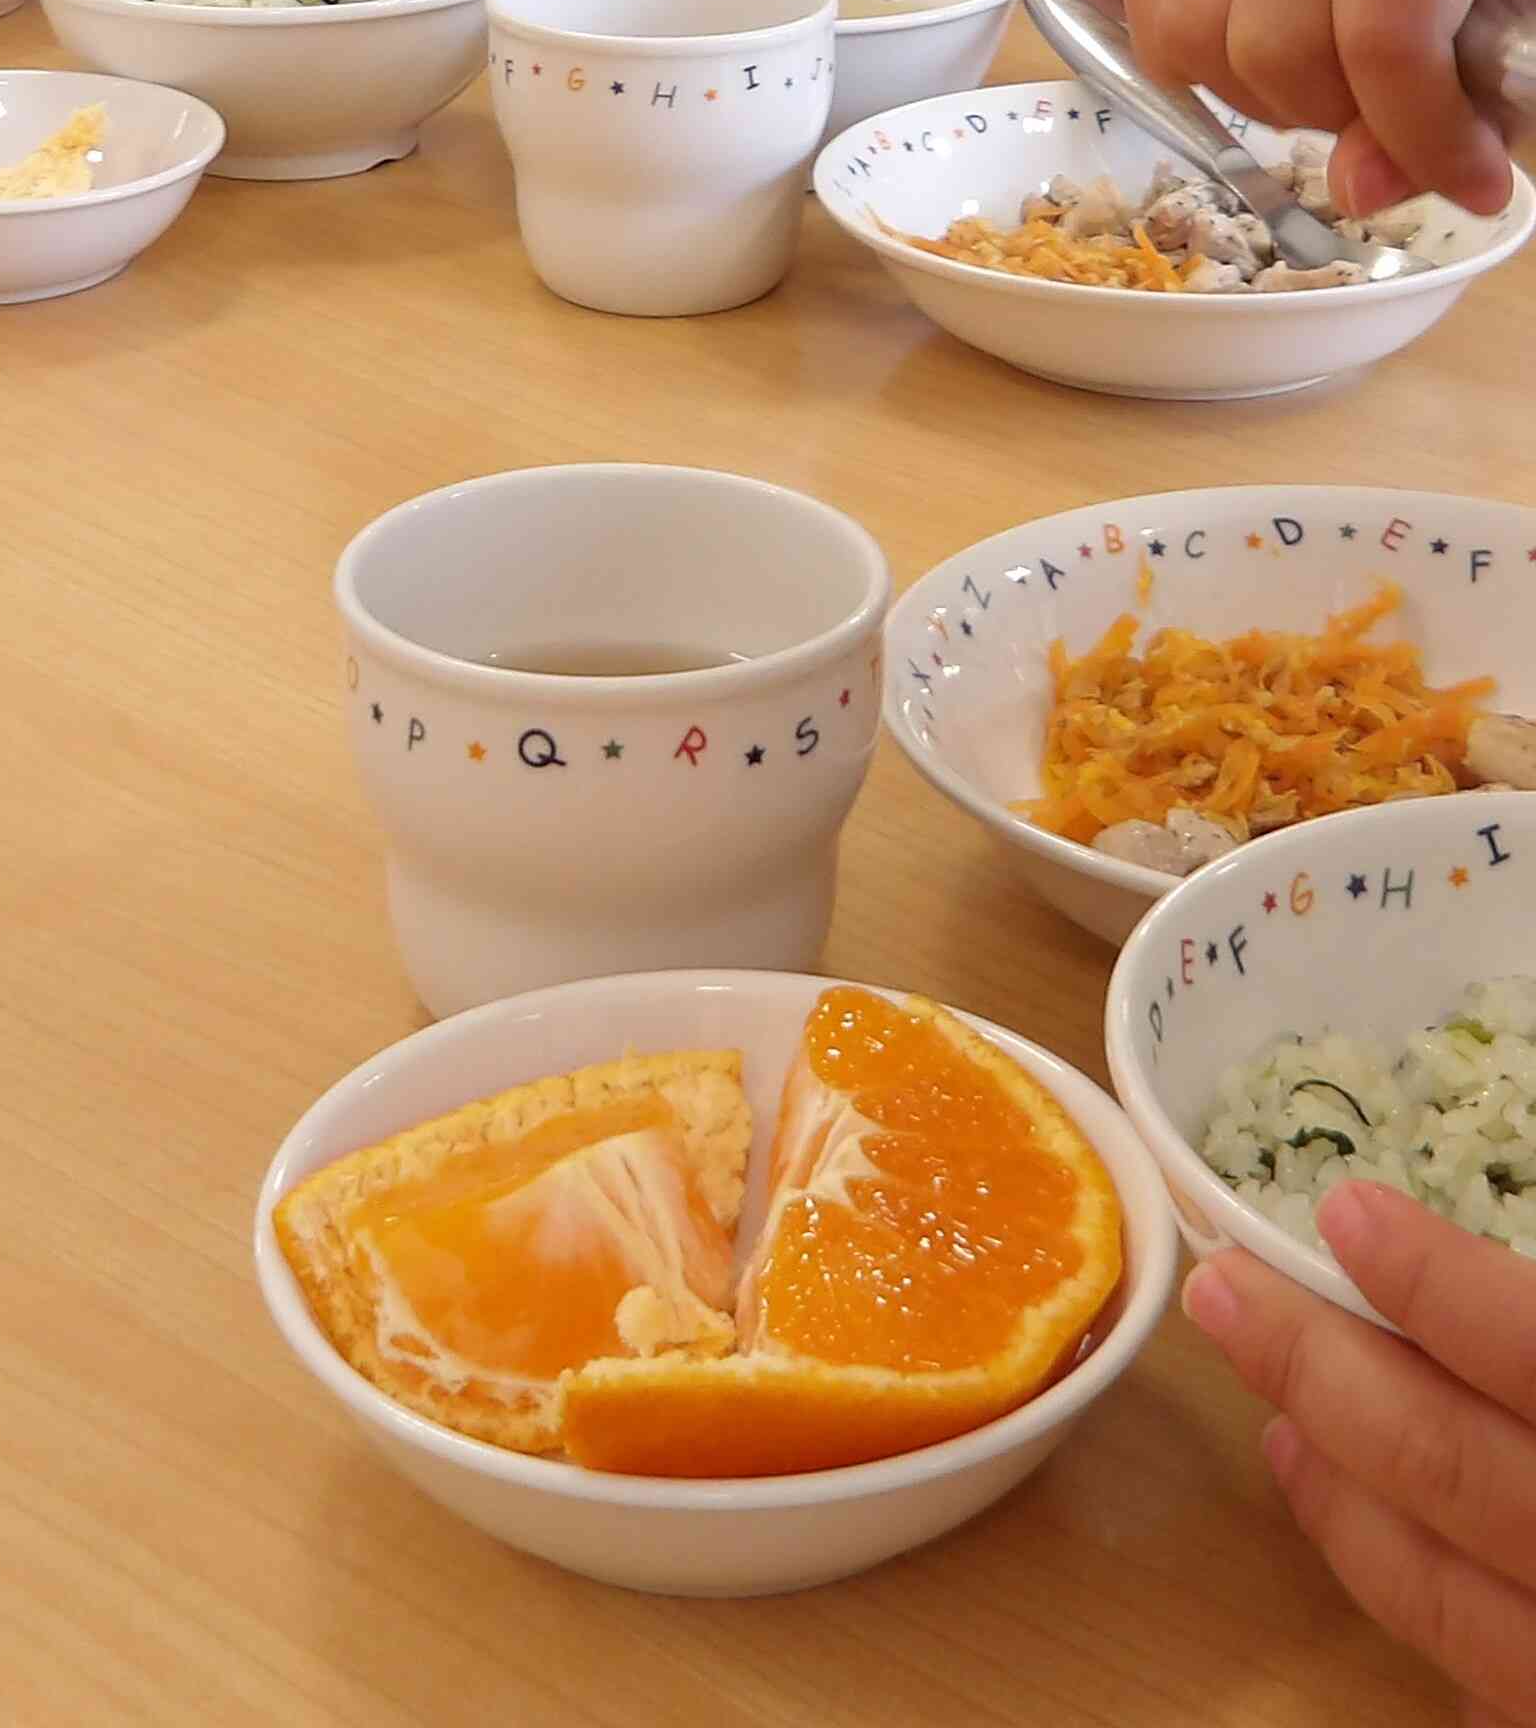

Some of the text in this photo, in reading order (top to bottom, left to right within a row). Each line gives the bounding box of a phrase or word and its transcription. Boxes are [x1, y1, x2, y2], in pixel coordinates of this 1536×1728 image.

[503, 58, 514, 88] F
[567, 66, 587, 91] G
[650, 80, 679, 109] H
[743, 63, 761, 91] I
[965, 113, 988, 134] D
[1095, 108, 1113, 135] F
[1039, 557, 1067, 591] A
[1103, 522, 1126, 555] B
[1183, 529, 1208, 560] C
[1272, 516, 1304, 546] D
[1380, 517, 1413, 553] E
[1468, 548, 1494, 583] F
[407, 716, 426, 752] P
[517, 727, 567, 769] Q
[673, 724, 708, 767] R
[794, 715, 821, 757] S
[1180, 937, 1196, 985] E
[1227, 924, 1249, 977] F
[1288, 871, 1314, 917] G
[1379, 867, 1415, 910] H
[1476, 822, 1512, 866] I
